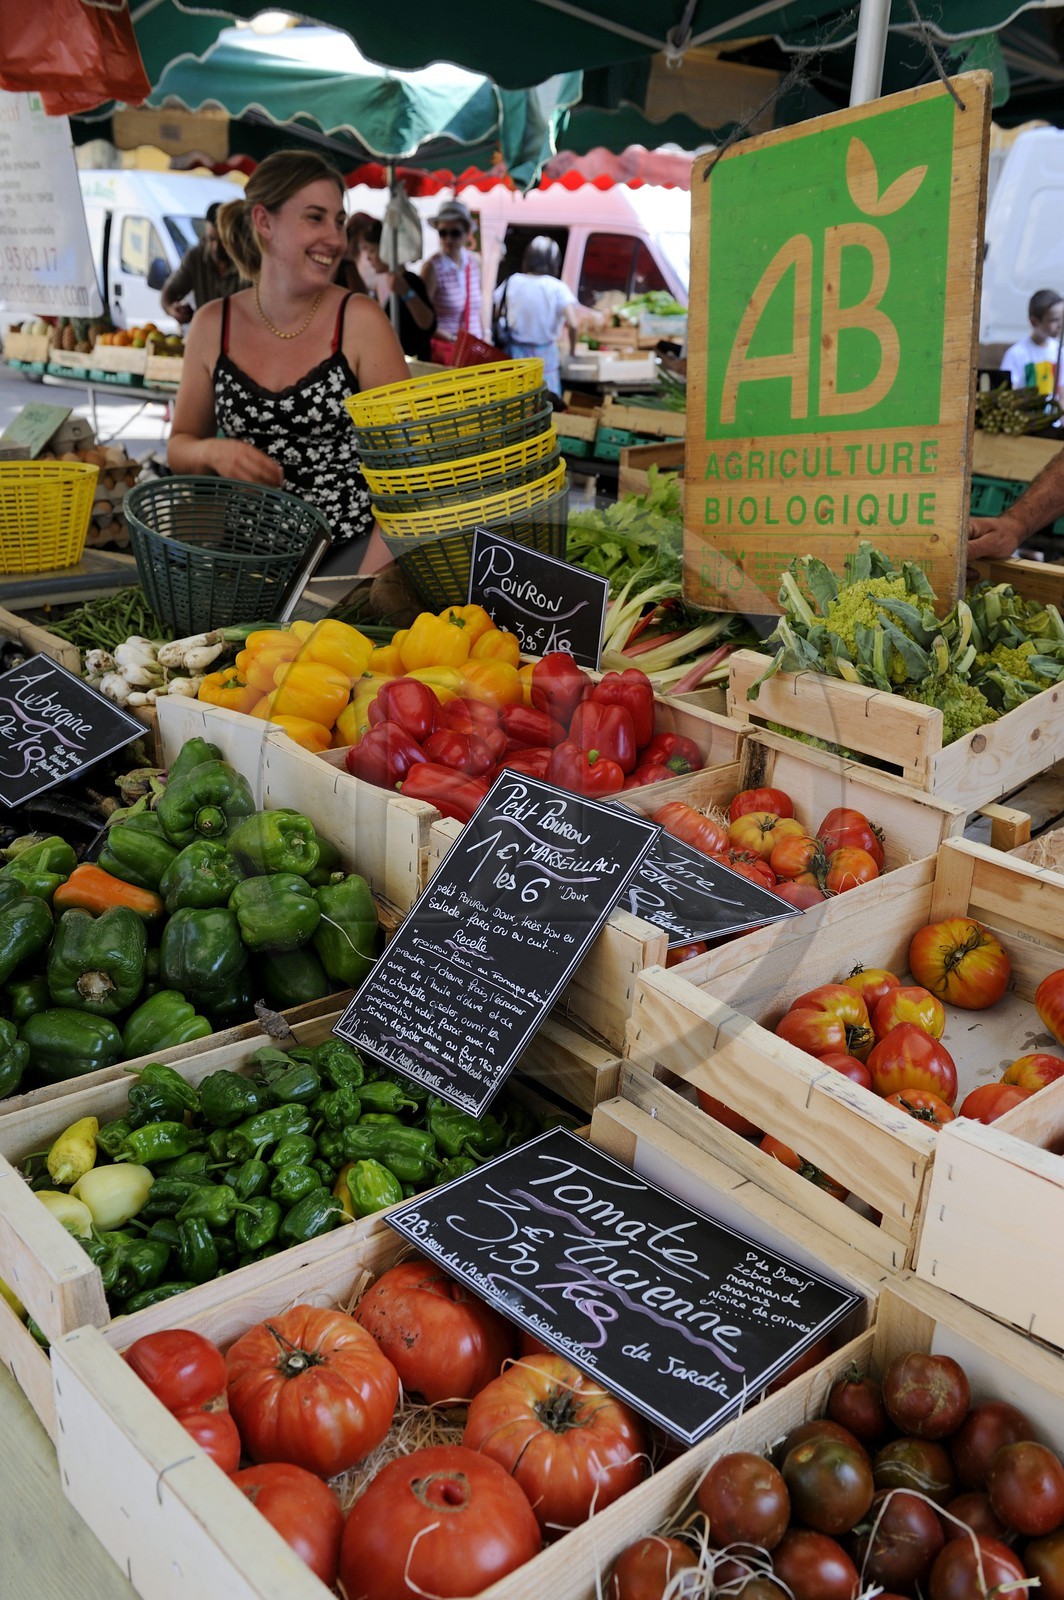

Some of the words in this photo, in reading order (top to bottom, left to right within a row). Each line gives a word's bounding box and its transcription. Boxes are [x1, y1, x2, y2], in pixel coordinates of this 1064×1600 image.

[720, 222, 900, 424] AB
[704, 439, 939, 480] AGRICULTURE
[704, 492, 936, 527] BIOLOGIQUE
[9, 669, 93, 740] Aubergine
[495, 784, 540, 820] Petit
[492, 863, 516, 890] les
[521, 877, 551, 902] 6
[638, 864, 684, 901] elle
[649, 851, 715, 892] Terre
[452, 929, 488, 954] Recette
[379, 968, 388, 981] la
[410, 970, 422, 981] de
[529, 1154, 710, 1280] Tomate
[443, 1251, 460, 1267] de
[755, 1259, 770, 1272] de
[562, 1231, 742, 1354] Ancienne
[720, 1283, 771, 1308] ananas
[752, 1306, 768, 1319] de
[621, 1342, 652, 1363] du
